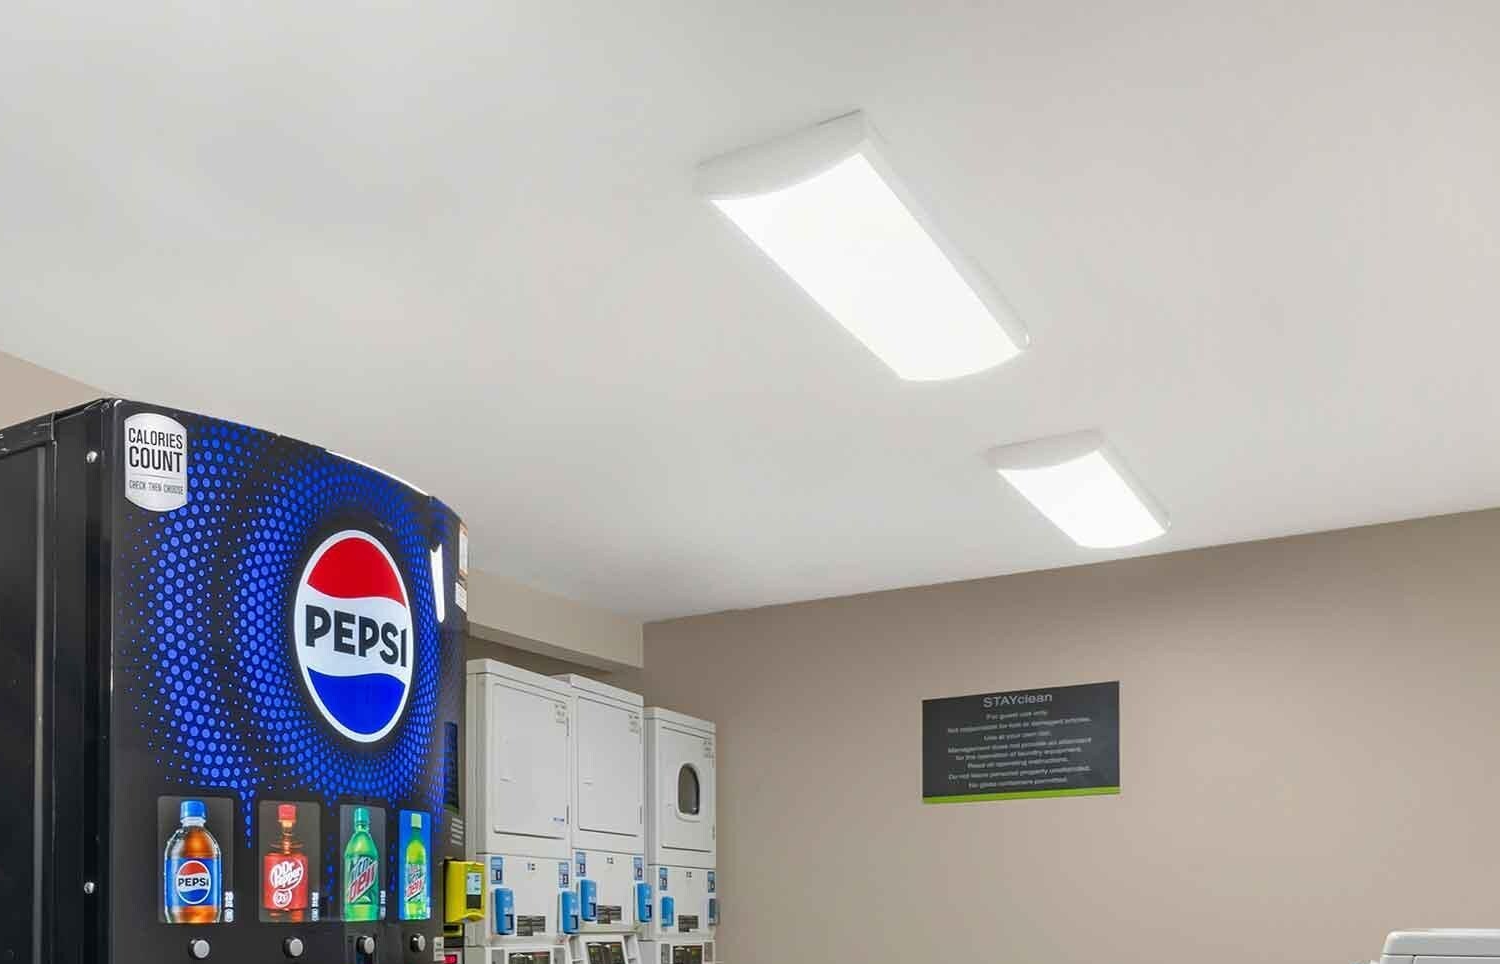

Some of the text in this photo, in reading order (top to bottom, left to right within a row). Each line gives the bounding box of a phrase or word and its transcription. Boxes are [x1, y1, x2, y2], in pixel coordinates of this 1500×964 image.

[128, 427, 183, 450] CALORIES
[129, 446, 183, 472] COUNT
[305, 604, 407, 667] PEPSI
[983, 693, 1053, 709] STAYclean
[178, 877, 209, 887] PEPSI
